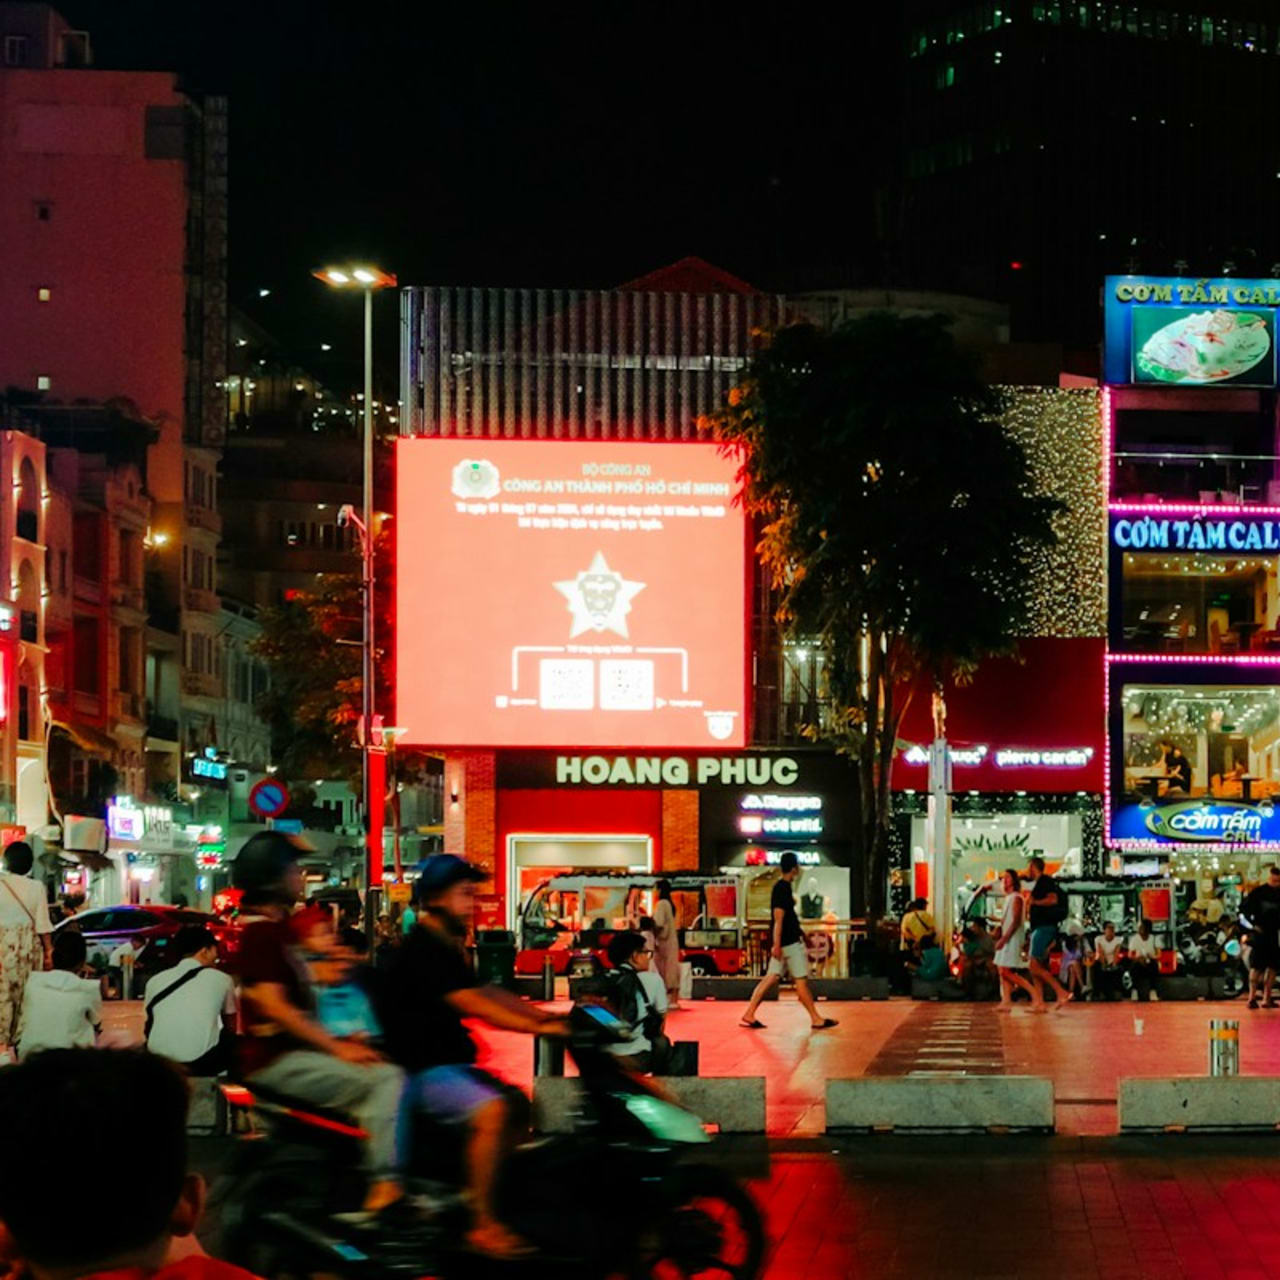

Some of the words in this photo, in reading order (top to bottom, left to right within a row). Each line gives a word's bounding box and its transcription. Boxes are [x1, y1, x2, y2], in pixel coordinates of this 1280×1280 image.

[503, 478, 541, 493] CÔNG
[543, 481, 564, 493] AN
[693, 482, 730, 496] MINH
[995, 750, 1040, 767] pierre
[1042, 749, 1088, 767] cardin
[556, 756, 690, 785] HOANG
[698, 757, 800, 785] PHUC
[1222, 830, 1261, 842] CALI
[766, 851, 820, 864] SURGA
